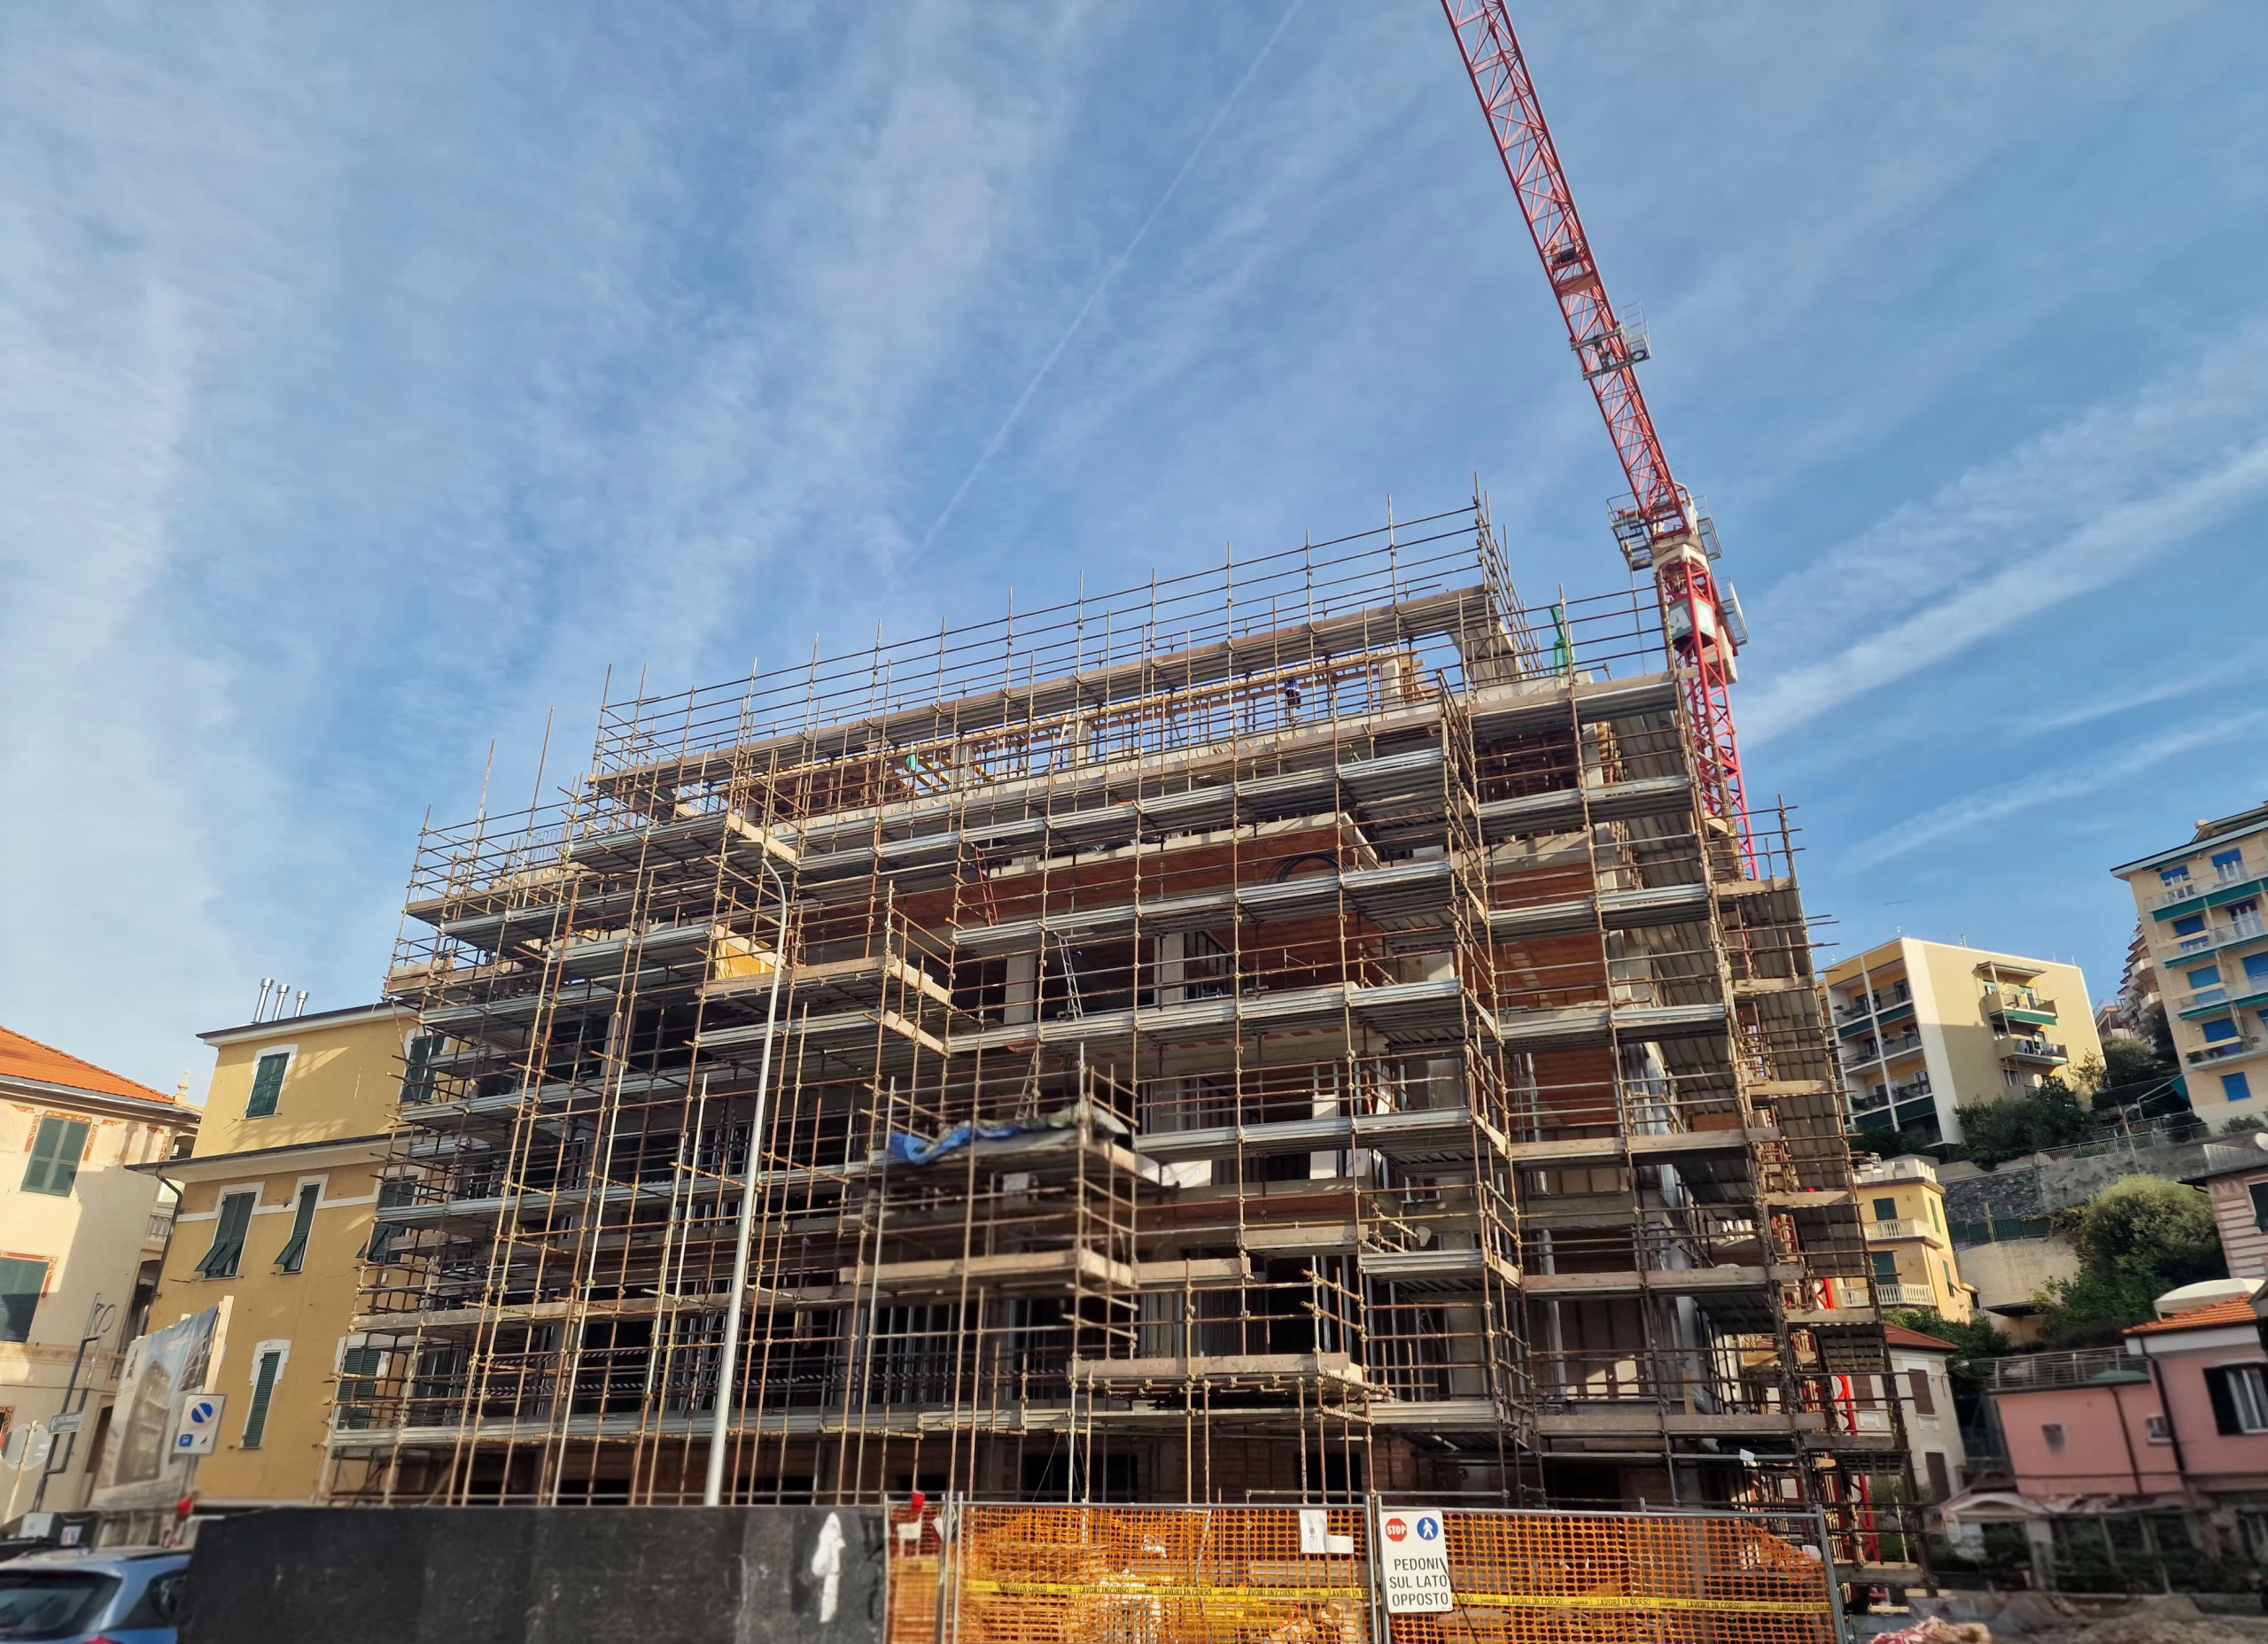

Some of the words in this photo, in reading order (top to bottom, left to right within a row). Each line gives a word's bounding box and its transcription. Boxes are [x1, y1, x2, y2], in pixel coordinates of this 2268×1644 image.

[1386, 1524, 1406, 1535] STOP
[1394, 1557, 1440, 1570] PEDONI
[1389, 1576, 1413, 1589] SUL
[1416, 1574, 1448, 1588] LATO
[1392, 1592, 1449, 1607] OPPOSTO
